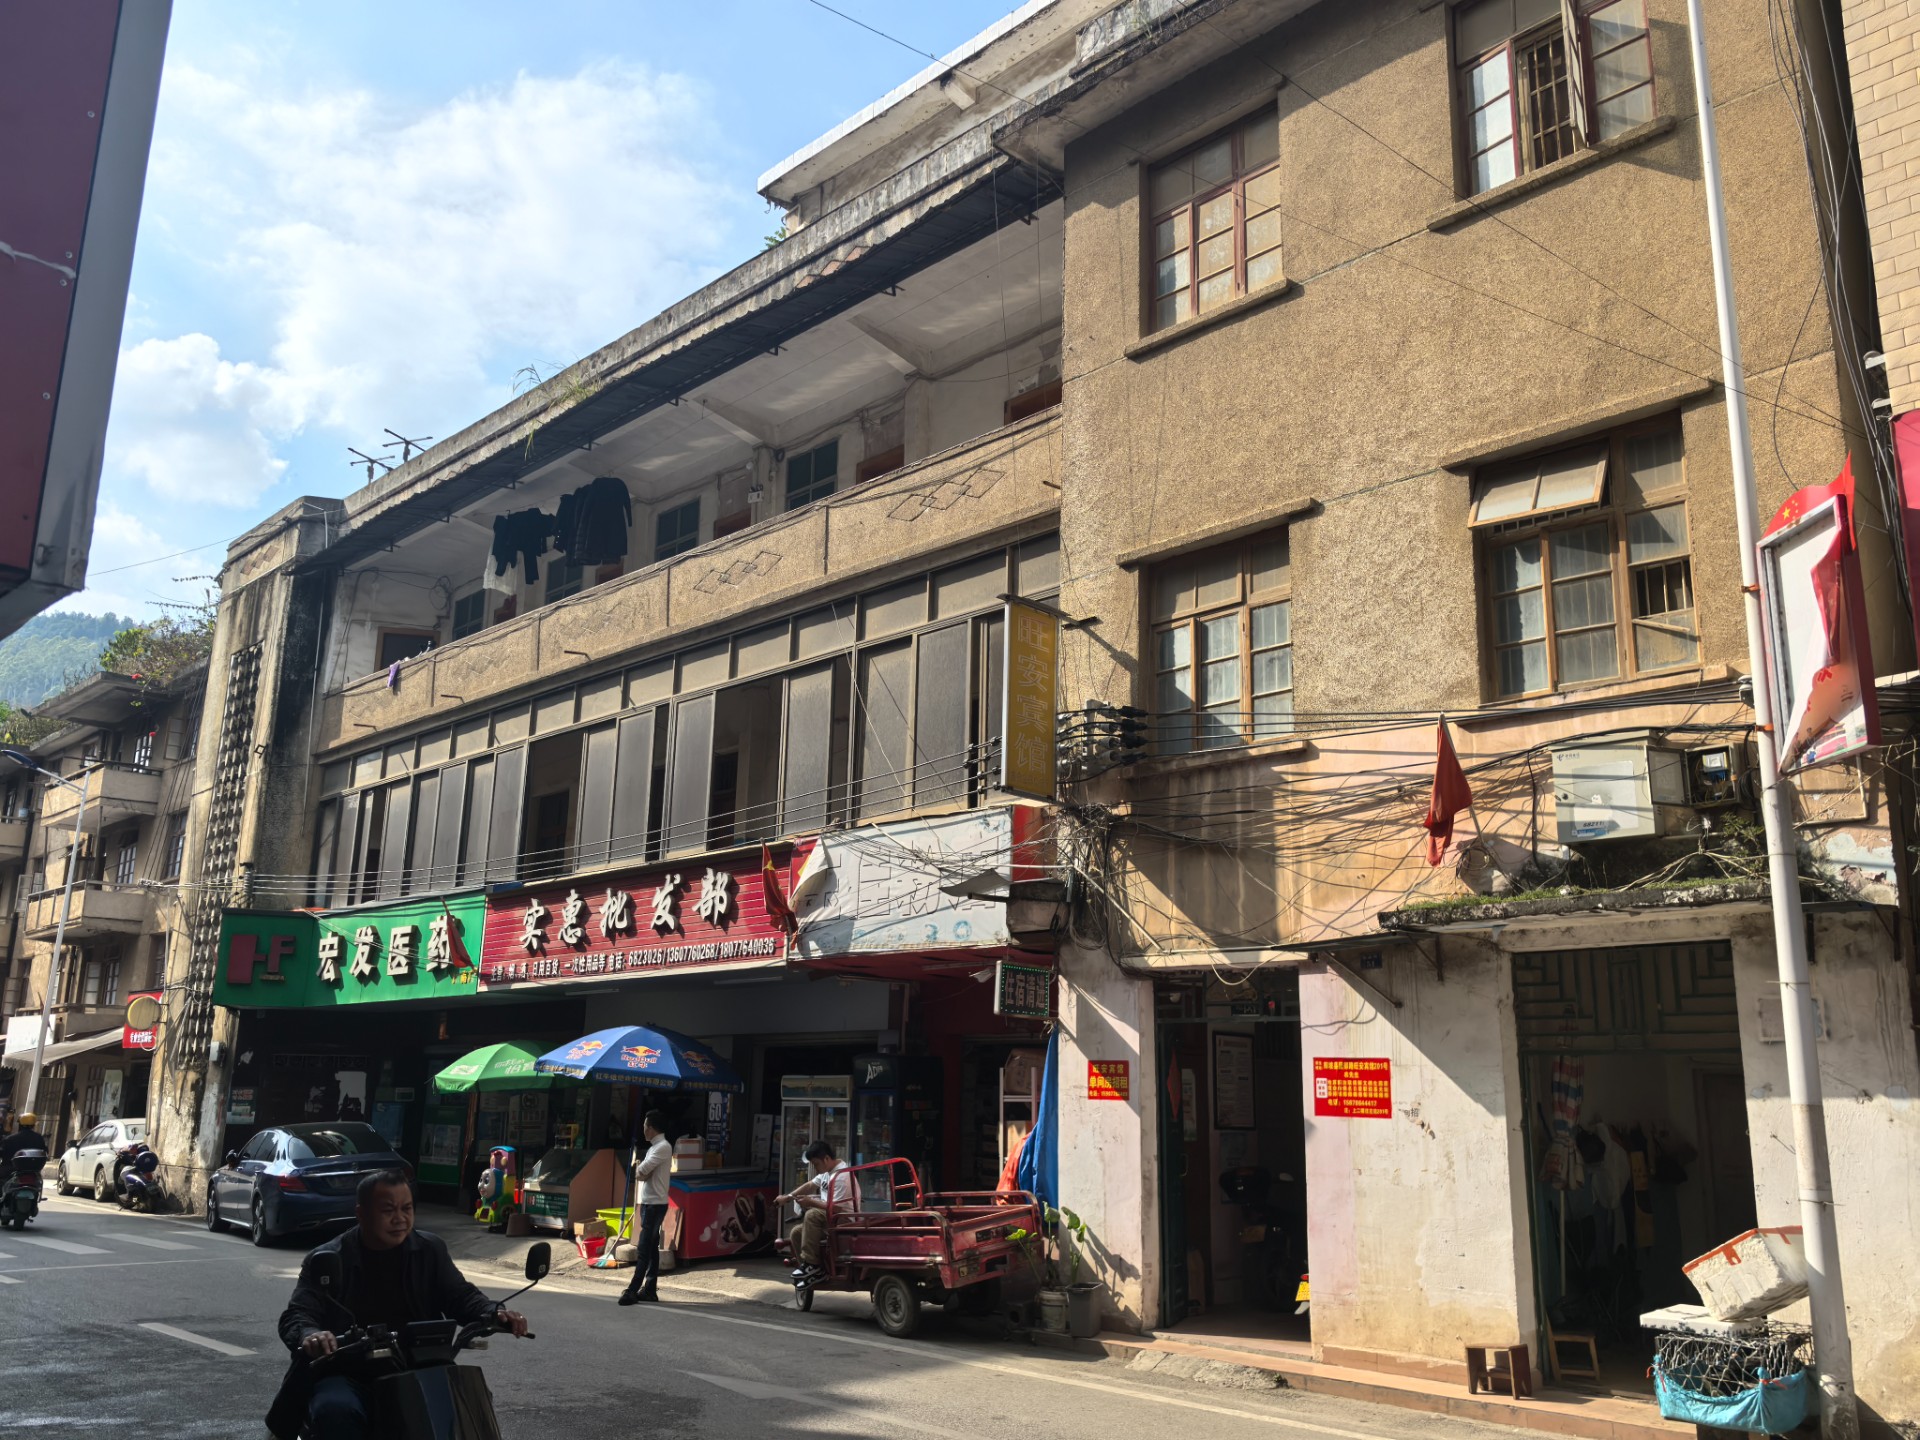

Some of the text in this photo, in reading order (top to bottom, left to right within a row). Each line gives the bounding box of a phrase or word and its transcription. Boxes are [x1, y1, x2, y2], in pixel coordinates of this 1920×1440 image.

[1014, 615, 1050, 774] 旺安宾馆
[519, 867, 733, 951] 实惠批发部
[316, 915, 455, 983] 宏发医药
[1089, 1075, 1128, 1089] 单间房招租
[1093, 1064, 1124, 1073] 旺安宾馆
